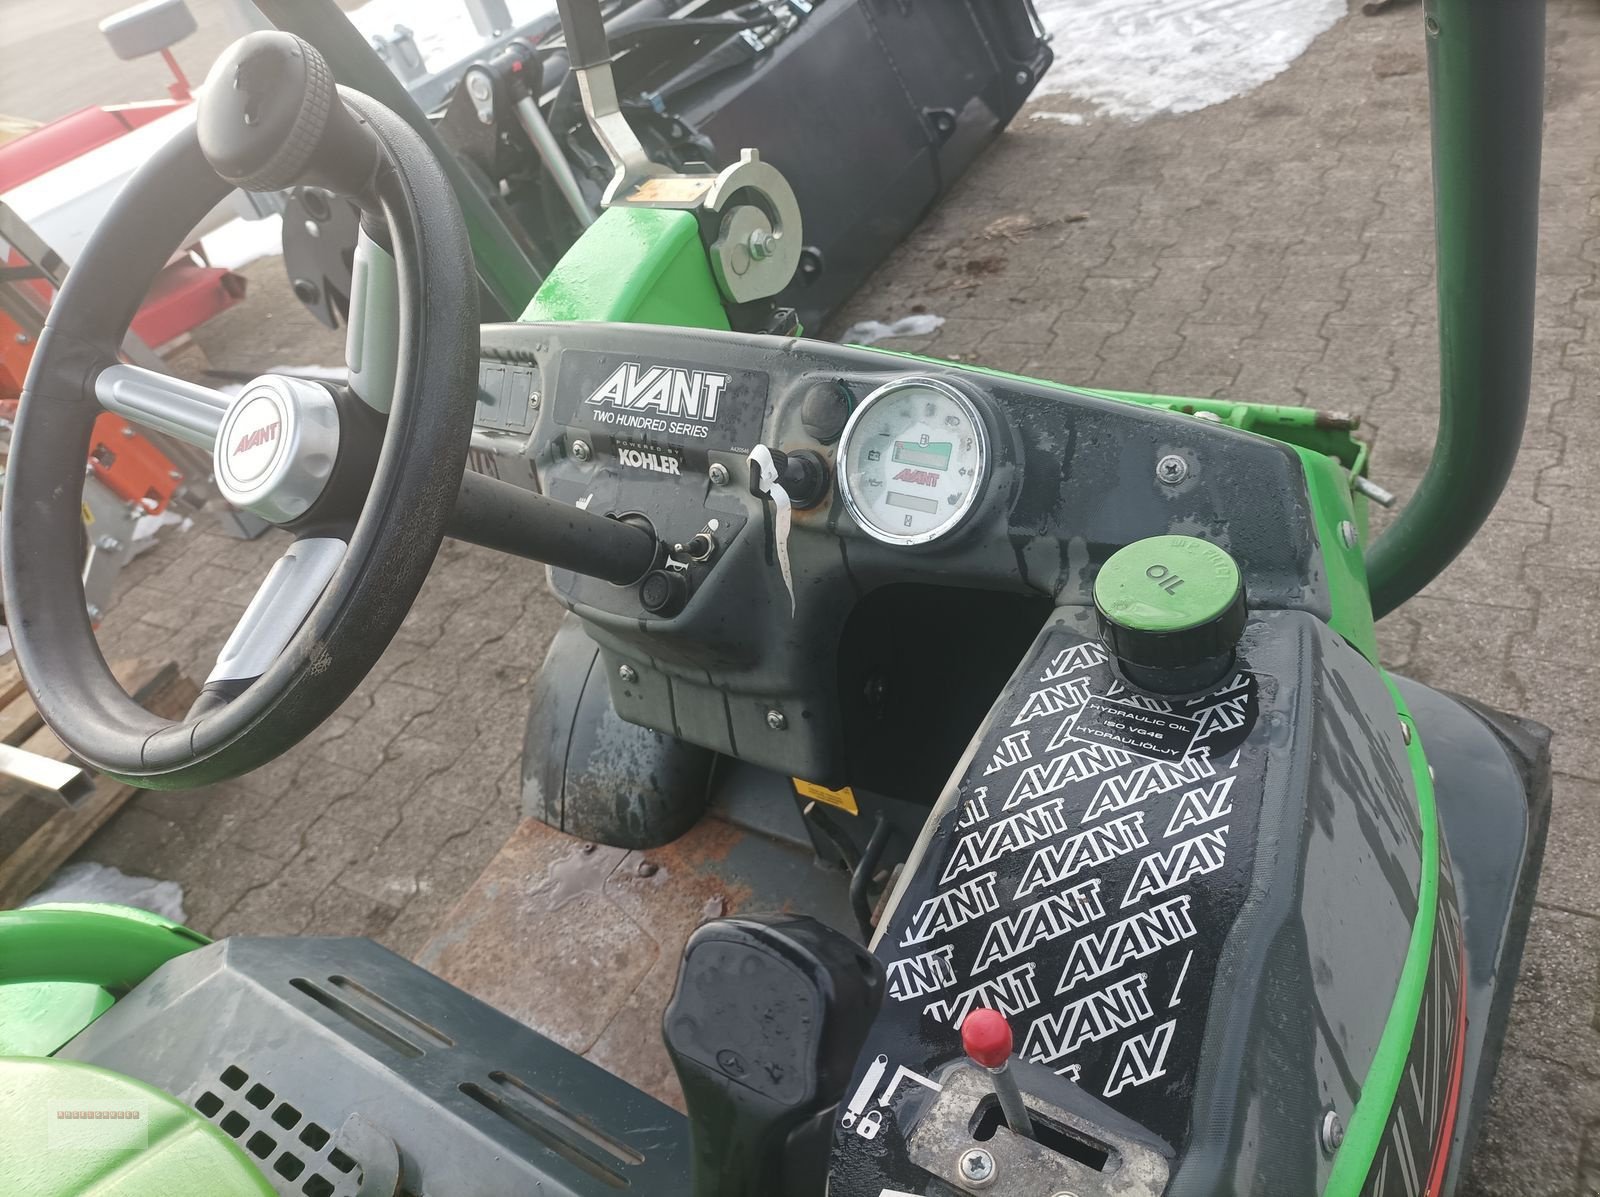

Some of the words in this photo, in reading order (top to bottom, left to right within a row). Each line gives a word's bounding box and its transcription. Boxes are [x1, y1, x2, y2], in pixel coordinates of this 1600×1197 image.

[585, 362, 730, 422] AVANT
[232, 421, 280, 457] AVANT
[593, 409, 615, 424] TWO
[615, 413, 667, 432] HUNDRED
[668, 421, 709, 438] SERIES
[616, 440, 661, 451] POWERED
[618, 448, 681, 476] KOHLER
[892, 468, 940, 487] AVANT
[1146, 564, 1185, 596] OIL
[1040, 641, 1109, 682] VAN
[1090, 703, 1165, 726] HYDRAULIC
[1169, 723, 1190, 733] OIL
[1104, 720, 1126, 730] ISO
[1128, 727, 1164, 739] VG46
[1002, 744, 1132, 812] AVANT
[1081, 746, 1216, 824] AVANT
[940, 798, 1068, 885] AVANT
[1013, 811, 1149, 900] AVANT
[900, 872, 1000, 947] VANT
[970, 879, 1106, 976] AVANT
[1054, 895, 1197, 996] AVANT
[1019, 973, 1154, 1064] AVANT
